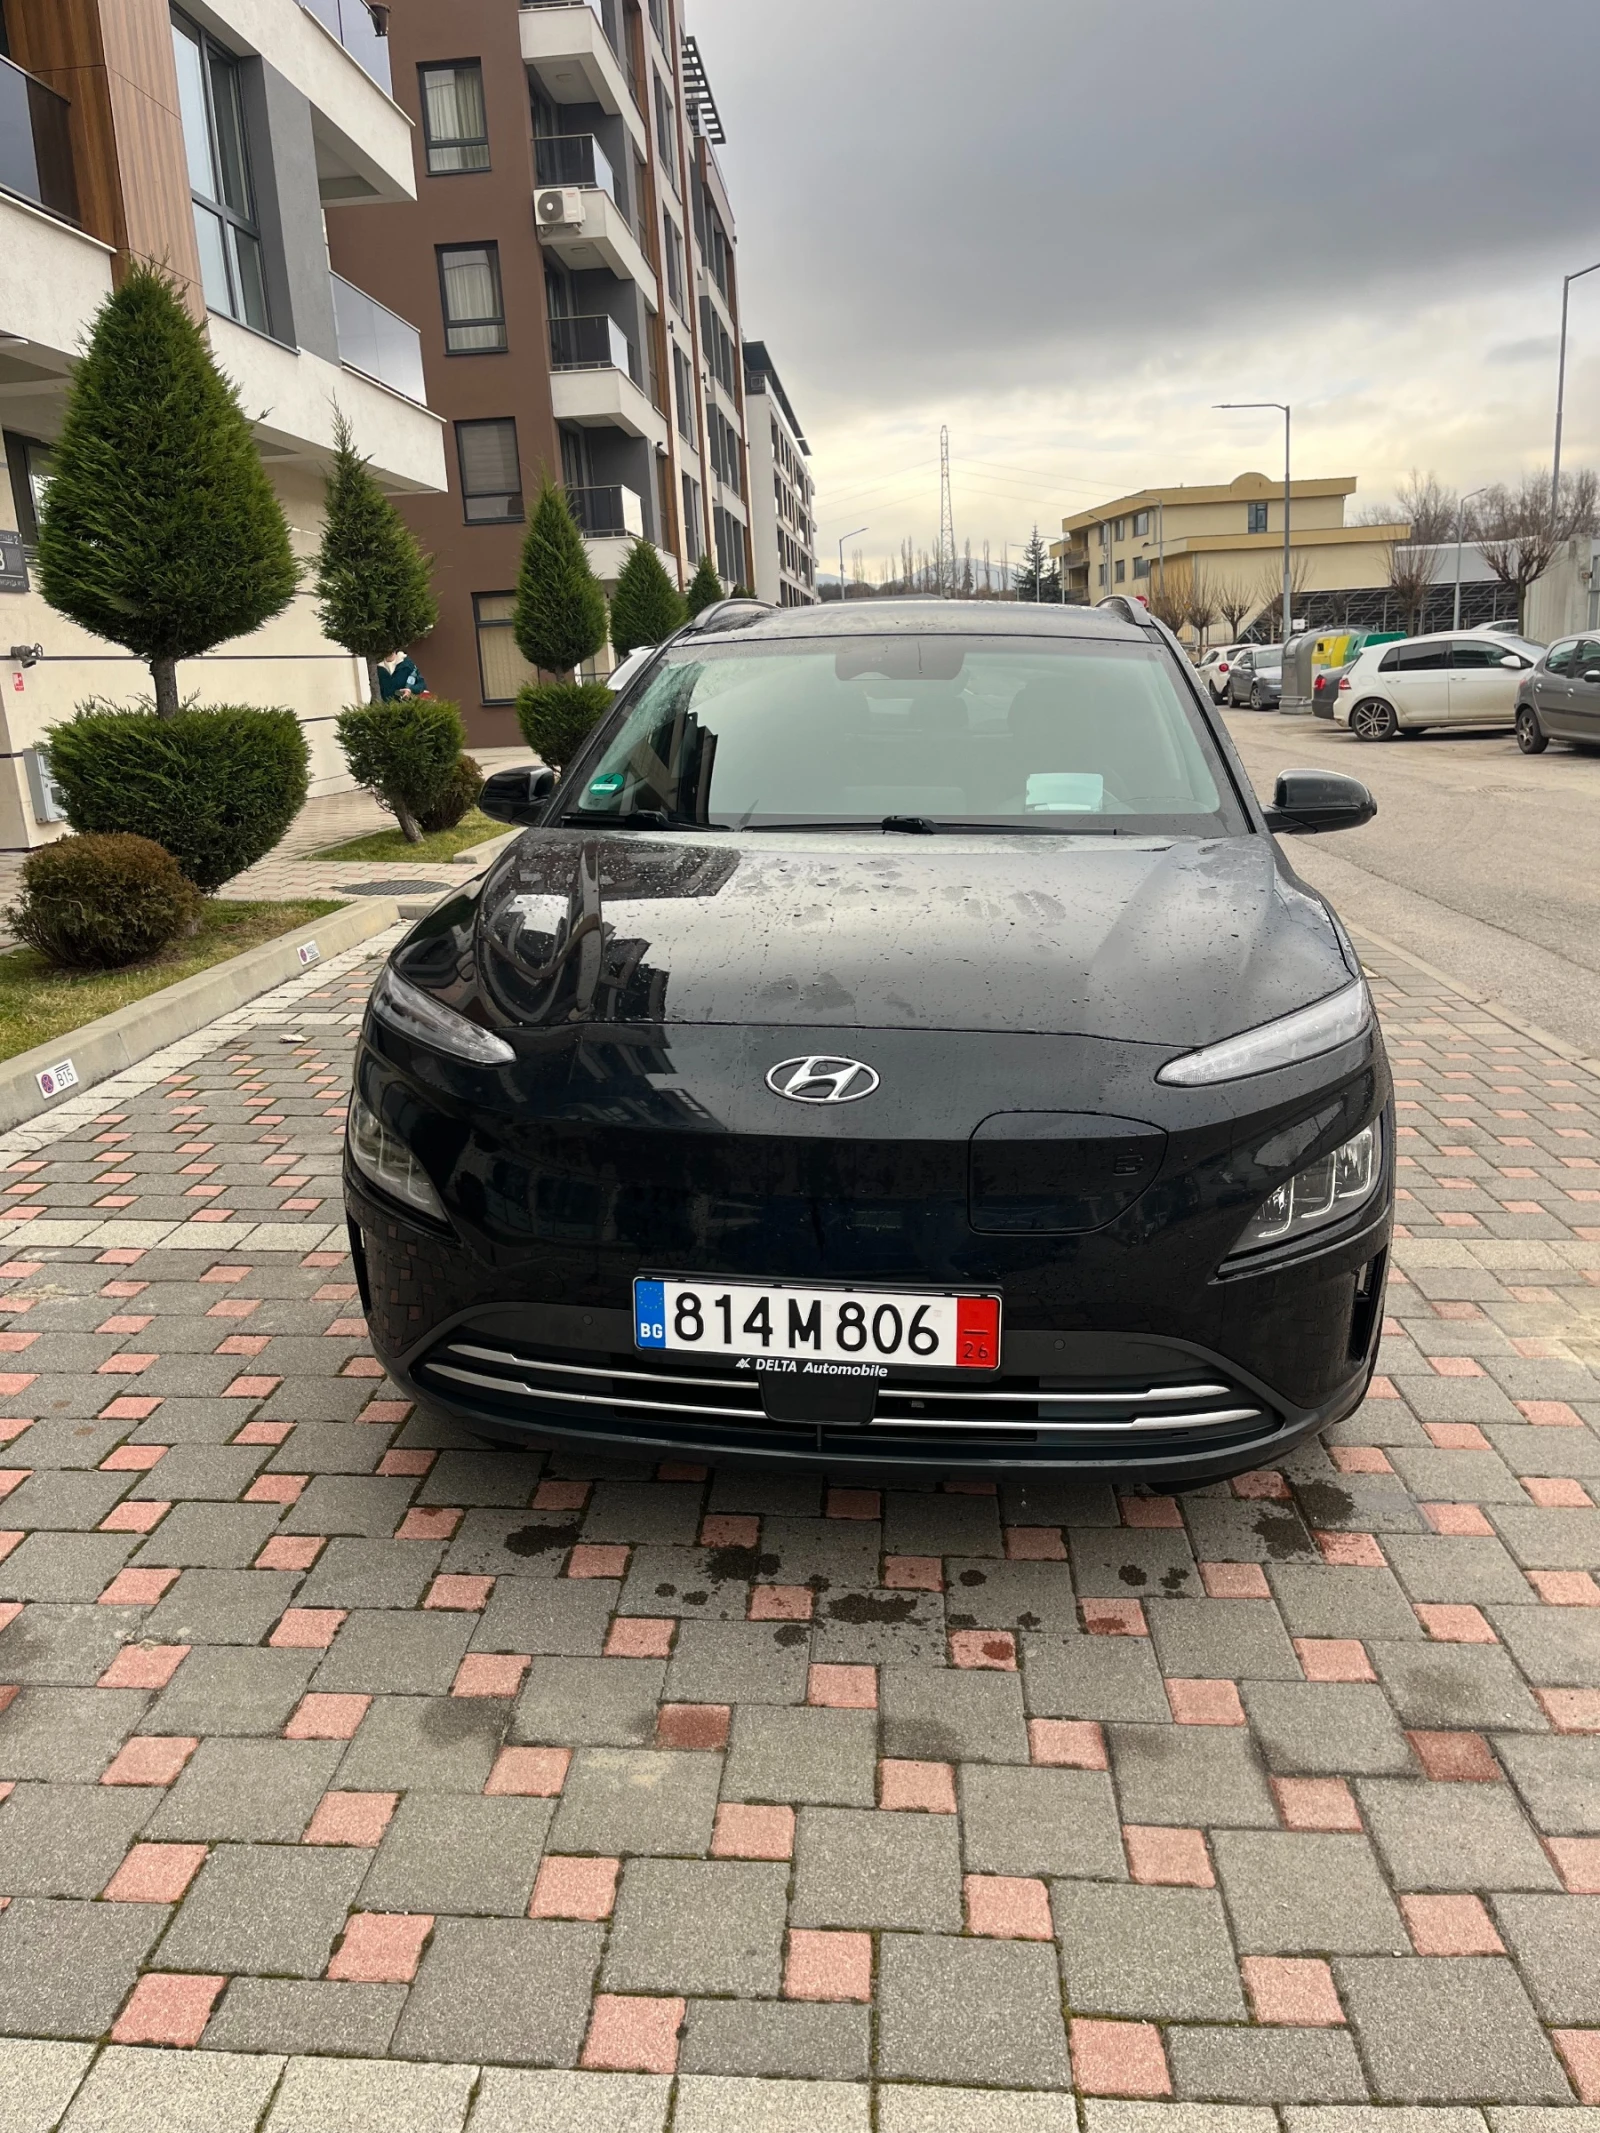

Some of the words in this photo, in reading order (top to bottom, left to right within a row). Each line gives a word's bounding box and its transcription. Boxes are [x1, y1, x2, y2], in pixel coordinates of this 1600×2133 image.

[640, 1322, 664, 1339] BG
[963, 1341, 989, 1359] 26
[755, 1358, 798, 1373] DELTA
[802, 1361, 889, 1378] Automobile
